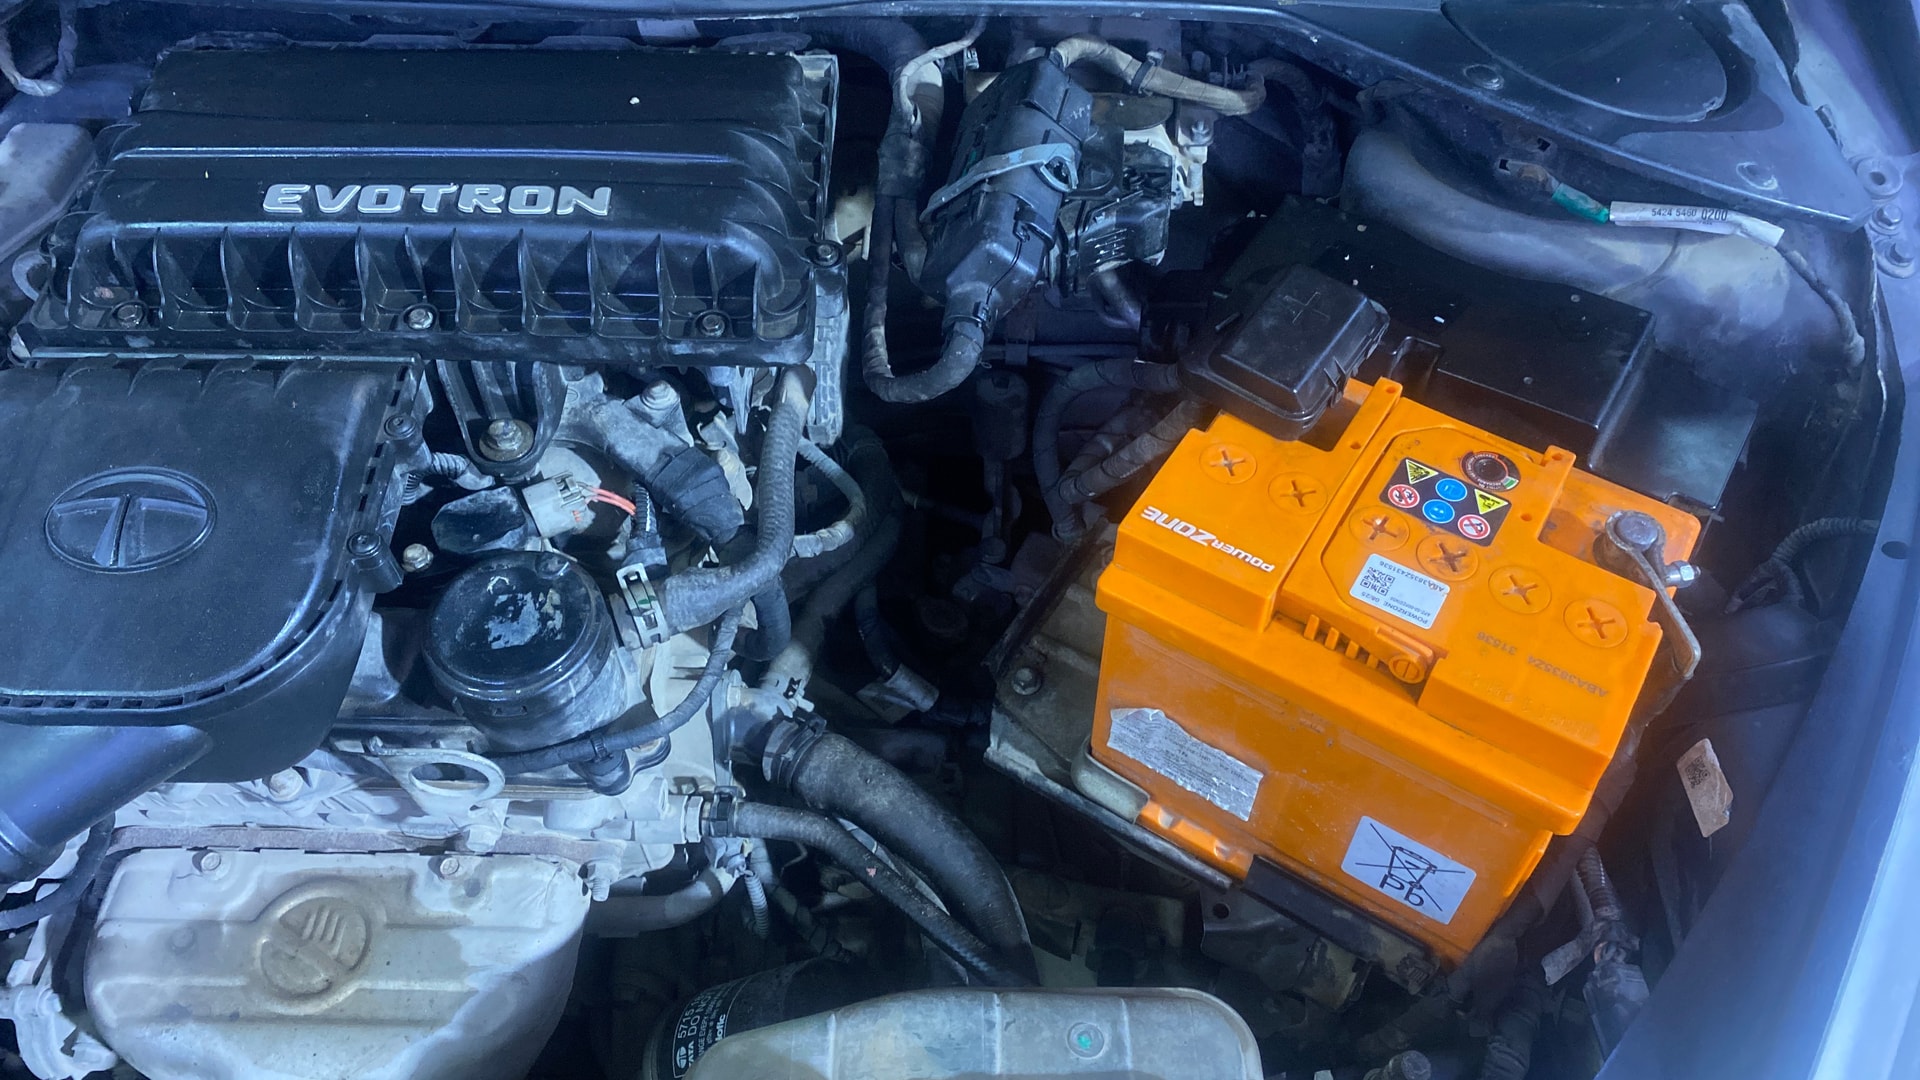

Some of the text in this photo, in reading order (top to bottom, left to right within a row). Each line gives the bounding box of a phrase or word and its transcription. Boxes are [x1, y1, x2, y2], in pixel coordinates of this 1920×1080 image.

[262, 183, 612, 216] EVOTRON
[1651, 207, 1673, 217] 5424
[1701, 208, 1728, 221] 0200
[1140, 505, 1275, 573] POWERZONE
[1382, 600, 1429, 625] POWERZONE
[677, 1008, 695, 1039] 5715
[687, 1015, 700, 1036] DO
